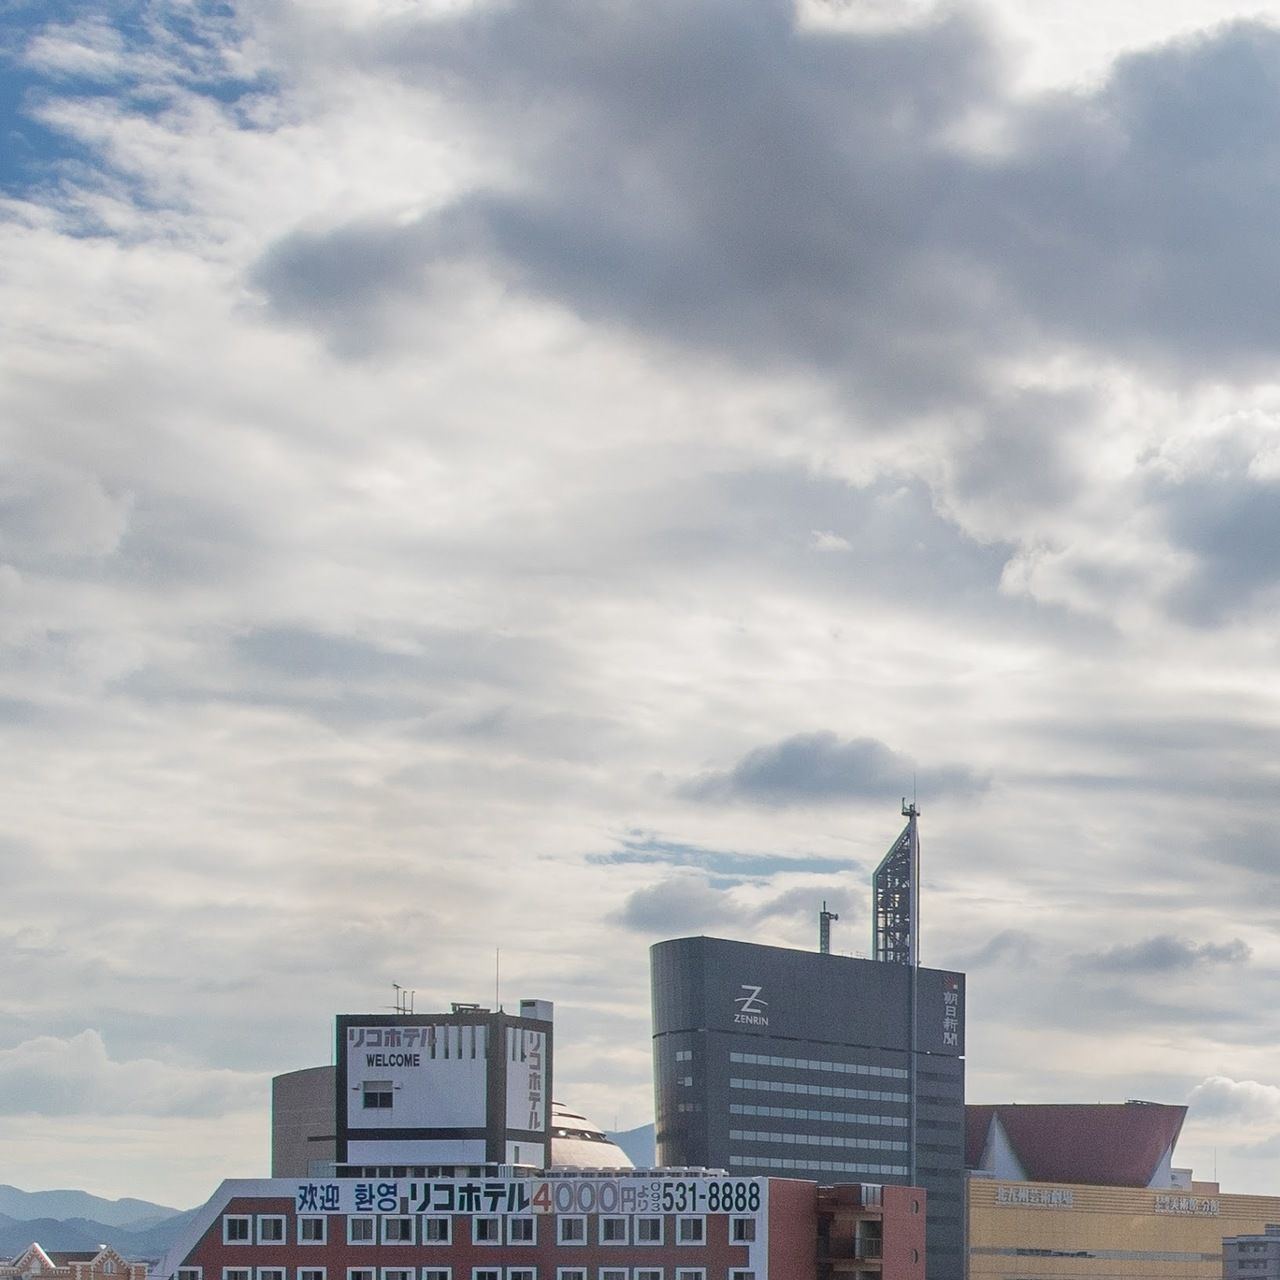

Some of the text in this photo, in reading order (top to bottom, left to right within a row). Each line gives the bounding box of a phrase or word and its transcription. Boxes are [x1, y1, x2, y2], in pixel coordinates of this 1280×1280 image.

[734, 1013, 769, 1026] ZENRIN
[350, 1028, 436, 1048] リコホテル
[366, 1054, 420, 1067] WELCOME
[528, 1033, 542, 1130] リコホテル
[298, 1183, 340, 1211] 欢迎
[355, 1183, 397, 1212] 환영
[411, 1182, 529, 1212] リコホテル
[662, 1182, 760, 1212] 531-8888
